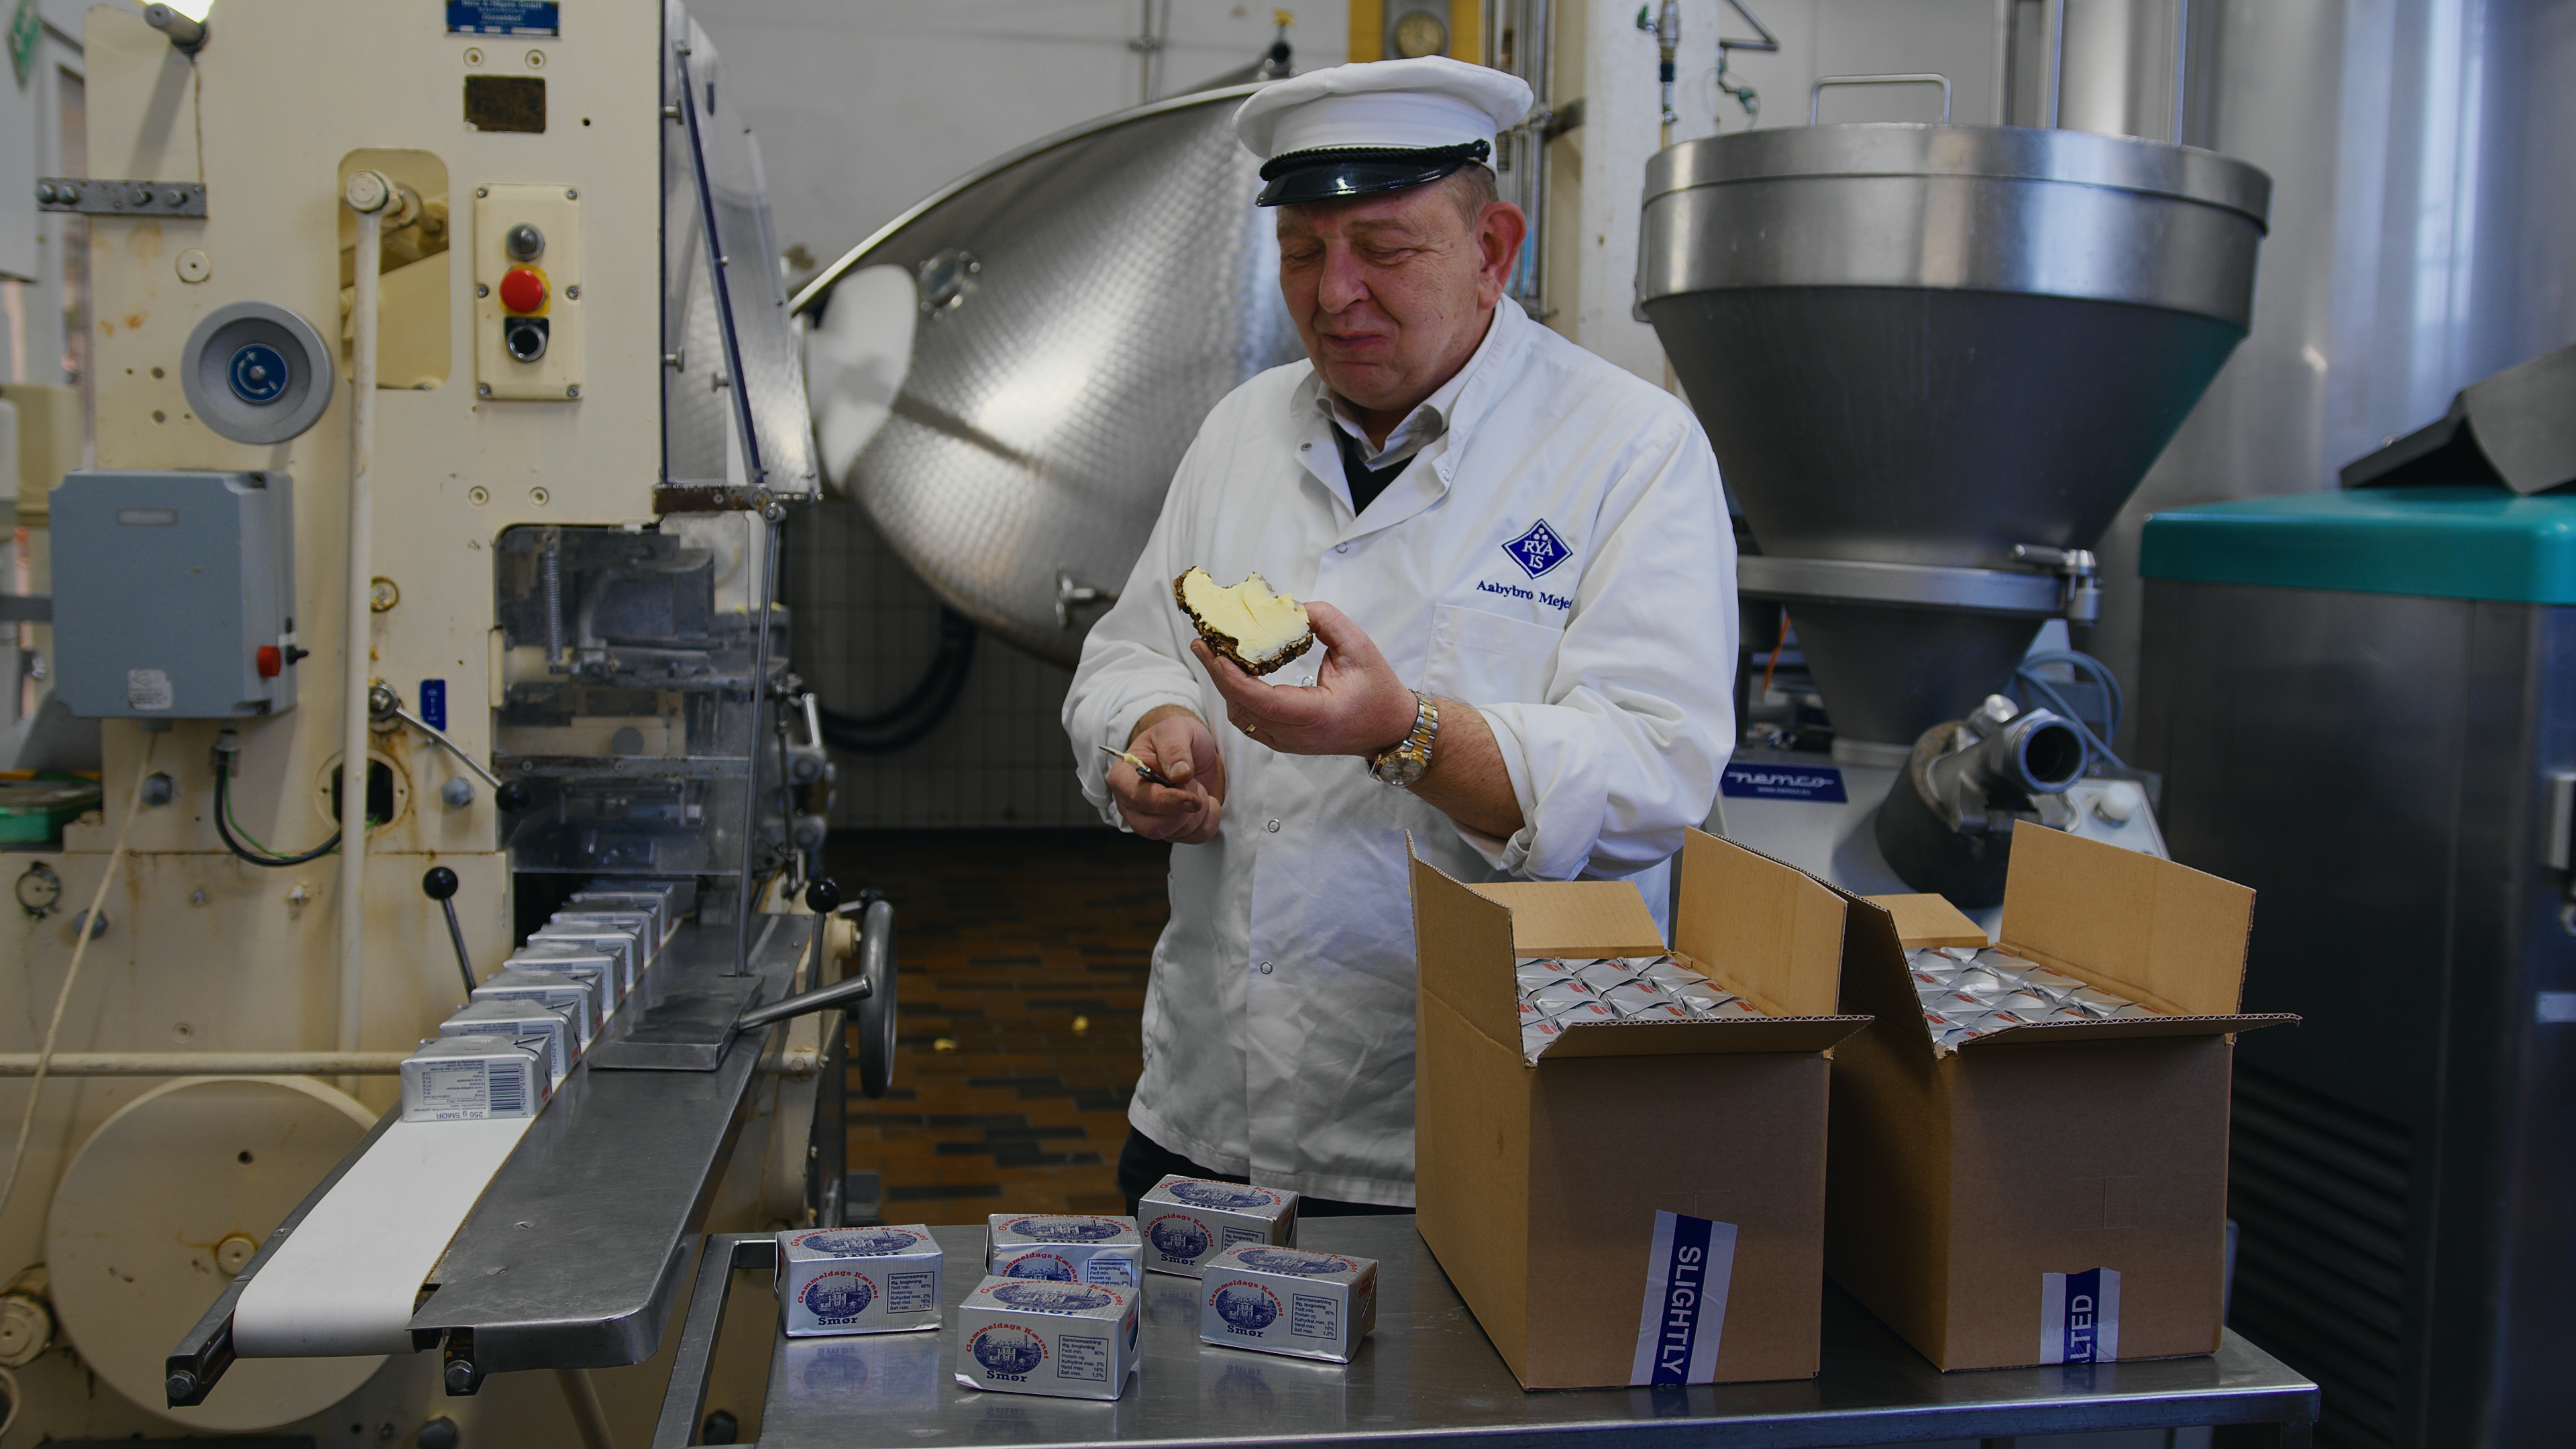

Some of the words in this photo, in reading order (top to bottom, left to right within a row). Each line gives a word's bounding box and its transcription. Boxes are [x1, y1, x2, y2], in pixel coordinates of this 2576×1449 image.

[1521, 539, 1554, 556] RYÅ
[1528, 554, 1544, 569] IS
[1477, 580, 1534, 600] Aabybro
[1727, 771, 1835, 788] nemco
[1144, 1214, 1191, 1238] Gammeldags
[1193, 1218, 1214, 1248] Kærnet
[1000, 1252, 1052, 1277] ammeldags
[1161, 1254, 1195, 1266] Smør
[798, 1271, 851, 1303] Gammeldags
[854, 1271, 878, 1299] Kærnet
[1209, 1280, 1258, 1307] Gammeldags
[1260, 1285, 1283, 1317] Kærnet
[1296, 1296, 1331, 1305] Sammensætning
[1662, 1246, 1701, 1375] SLIGHTLY
[818, 1317, 858, 1326] Smør
[2070, 1295, 2092, 1363] LTED
[1228, 1324, 1264, 1338] Smør
[966, 1322, 1021, 1352] Gammeldags
[1024, 1327, 1049, 1359] Kærnet
[1062, 1338, 1102, 1346] Sammensætning
[986, 1370, 1027, 1382] Smør
